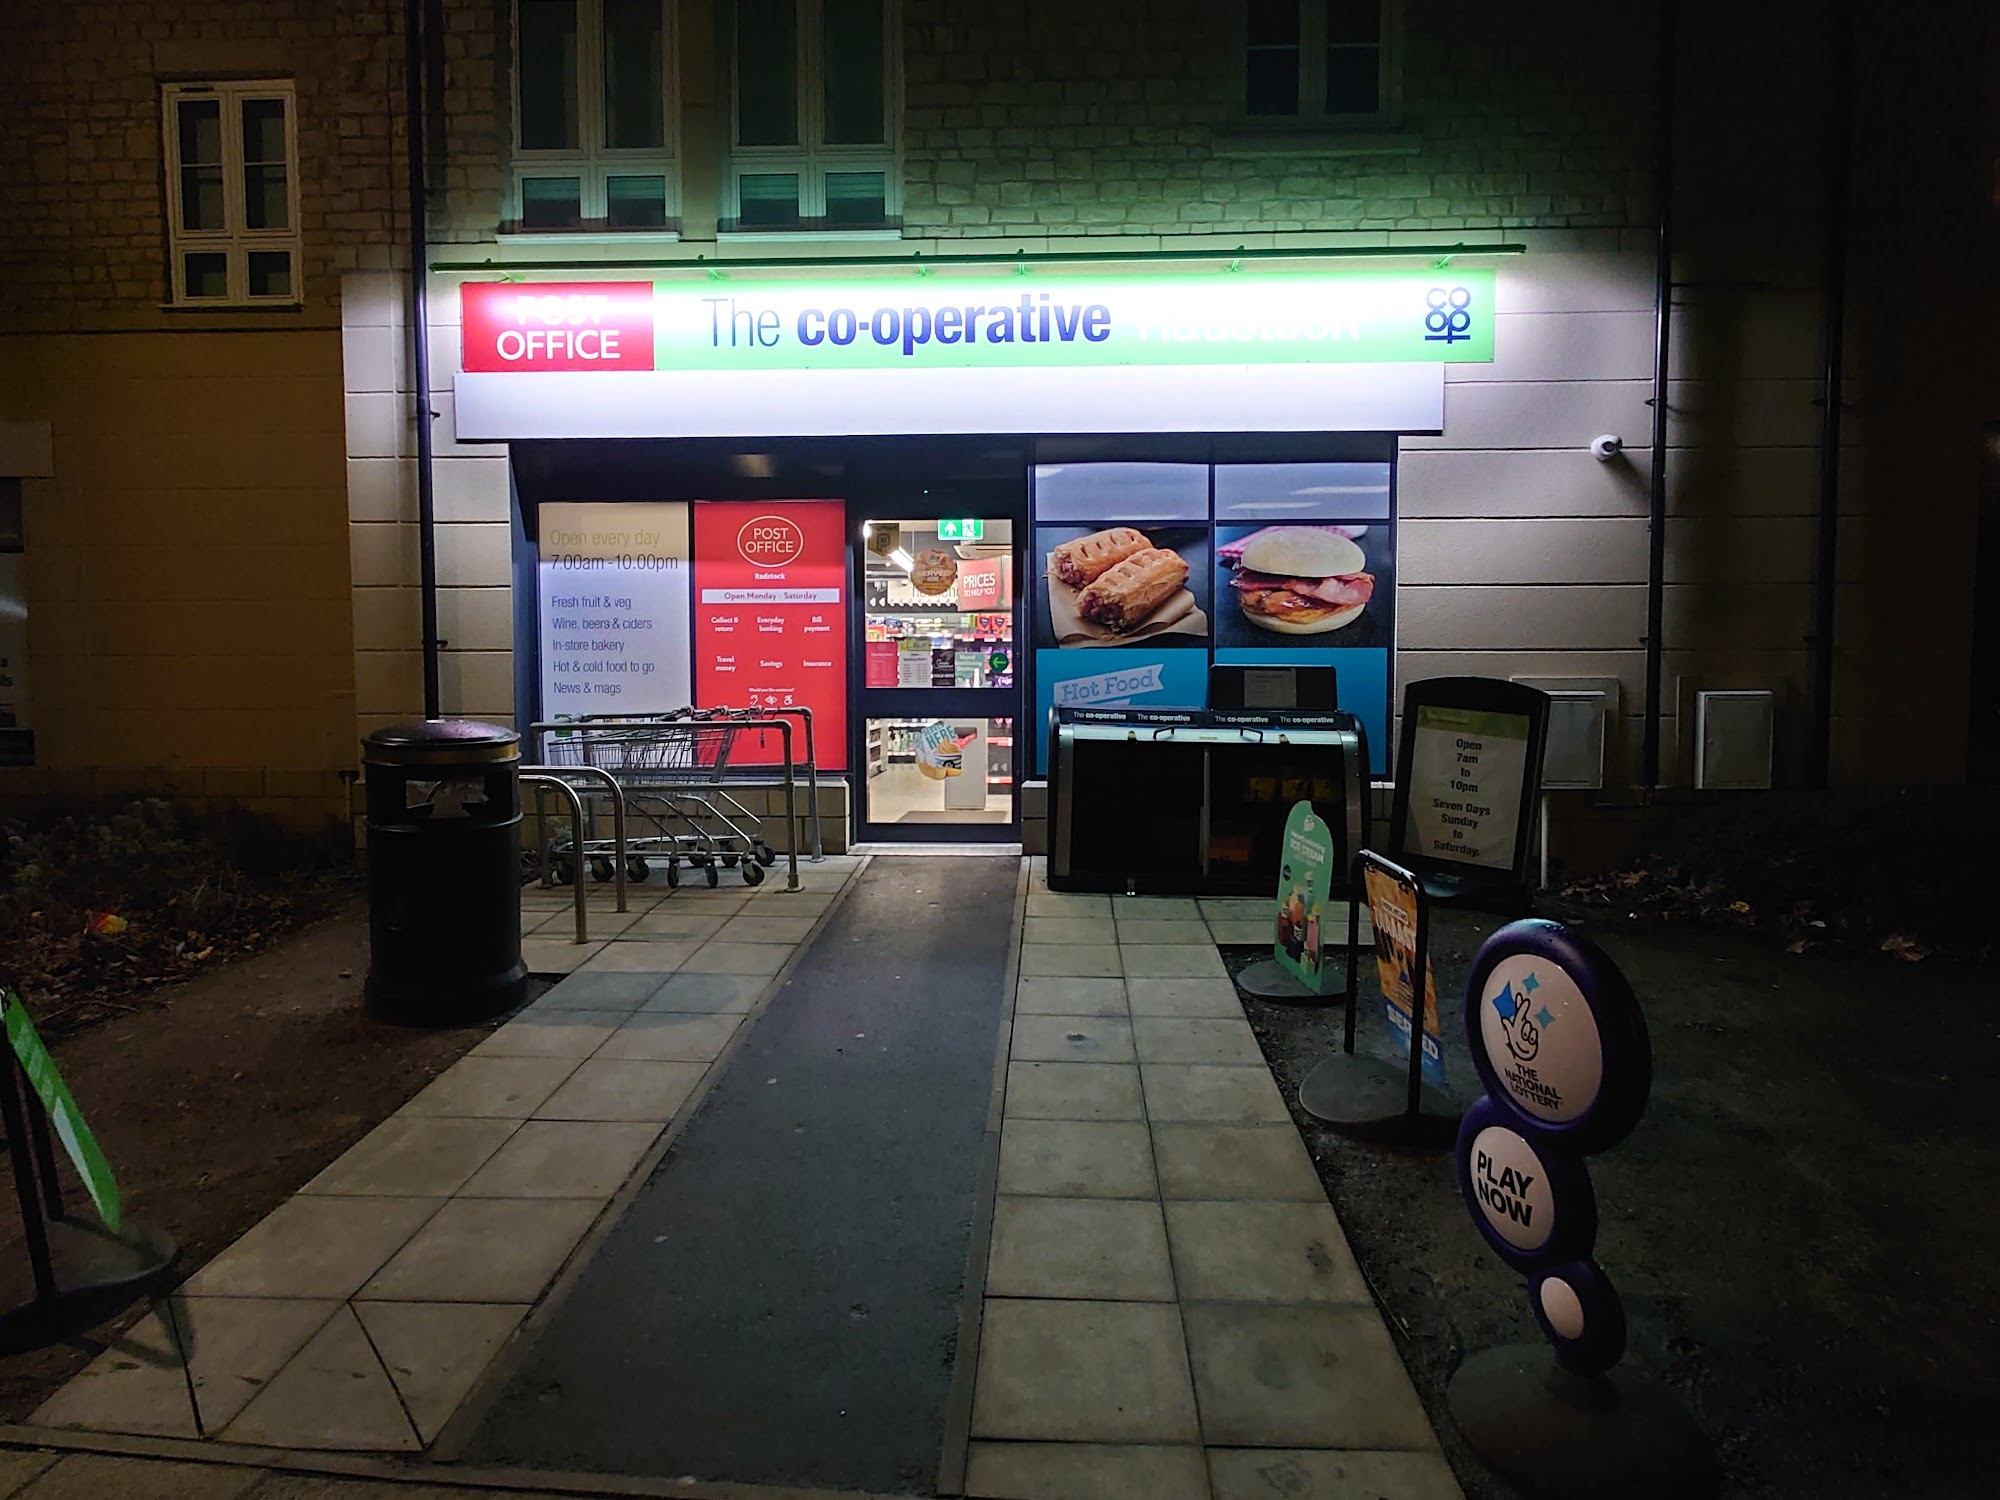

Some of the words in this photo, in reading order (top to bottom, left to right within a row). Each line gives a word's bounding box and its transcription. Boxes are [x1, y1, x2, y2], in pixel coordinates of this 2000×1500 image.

[518, 295, 608, 328] POST
[701, 298, 781, 348] The
[797, 293, 1111, 355] co-operative
[497, 329, 620, 361] OFFICE
[551, 530, 587, 548] Open
[592, 533, 630, 549] every
[635, 529, 661, 549] day
[753, 527, 789, 540] POST
[745, 541, 794, 553] OFFICE
[551, 554, 604, 570] 7.00am
[614, 553, 679, 573] 10.00pm
[754, 572, 785, 580] Radstock
[963, 573, 996, 589] PRICES
[724, 592, 745, 602] Open
[747, 592, 777, 601] Monday
[784, 592, 817, 601] Saturday
[964, 589, 971, 597] TO
[984, 587, 995, 596] YOU
[551, 596, 579, 608] Fresh
[581, 596, 601, 608] fruit
[603, 596, 612, 608] &
[614, 598, 632, 610] veg
[552, 618, 580, 631] Wine,
[582, 618, 610, 630] beers
[612, 618, 620, 630] &
[623, 618, 652, 630] ciders
[553, 639, 589, 651] In-store
[592, 639, 624, 653] bakery
[553, 661, 570, 672] Hot
[573, 661, 581, 672] &
[583, 661, 603, 672] cold
[605, 661, 628, 672] food
[630, 662, 639, 672] to
[642, 663, 655, 674] go
[554, 682, 581, 694] News
[584, 682, 592, 694] &
[594, 684, 622, 696] mags
[1062, 682, 1099, 702] Hot
[1104, 670, 1154, 695] Food
[1085, 711, 1127, 720] co-operative
[1149, 714, 1191, 722] co-operative
[1227, 715, 1269, 723] co-operative
[1292, 716, 1334, 724] co-operative
[1456, 738, 1482, 750] Open
[1456, 753, 1478, 764] 7am
[1460, 767, 1471, 777] to
[1450, 780, 1478, 793] 10pm
[1433, 798, 1463, 811] Seven
[1466, 802, 1490, 816] Days
[1441, 813, 1478, 829] Sunday
[1453, 829, 1463, 839] to
[1515, 1062, 1539, 1081] THE
[1505, 1068, 1562, 1099] NATIONAL
[1510, 1081, 1559, 1110] LOTTERY
[1478, 1150, 1534, 1199] PLAY
[1478, 1177, 1533, 1227] NOW
